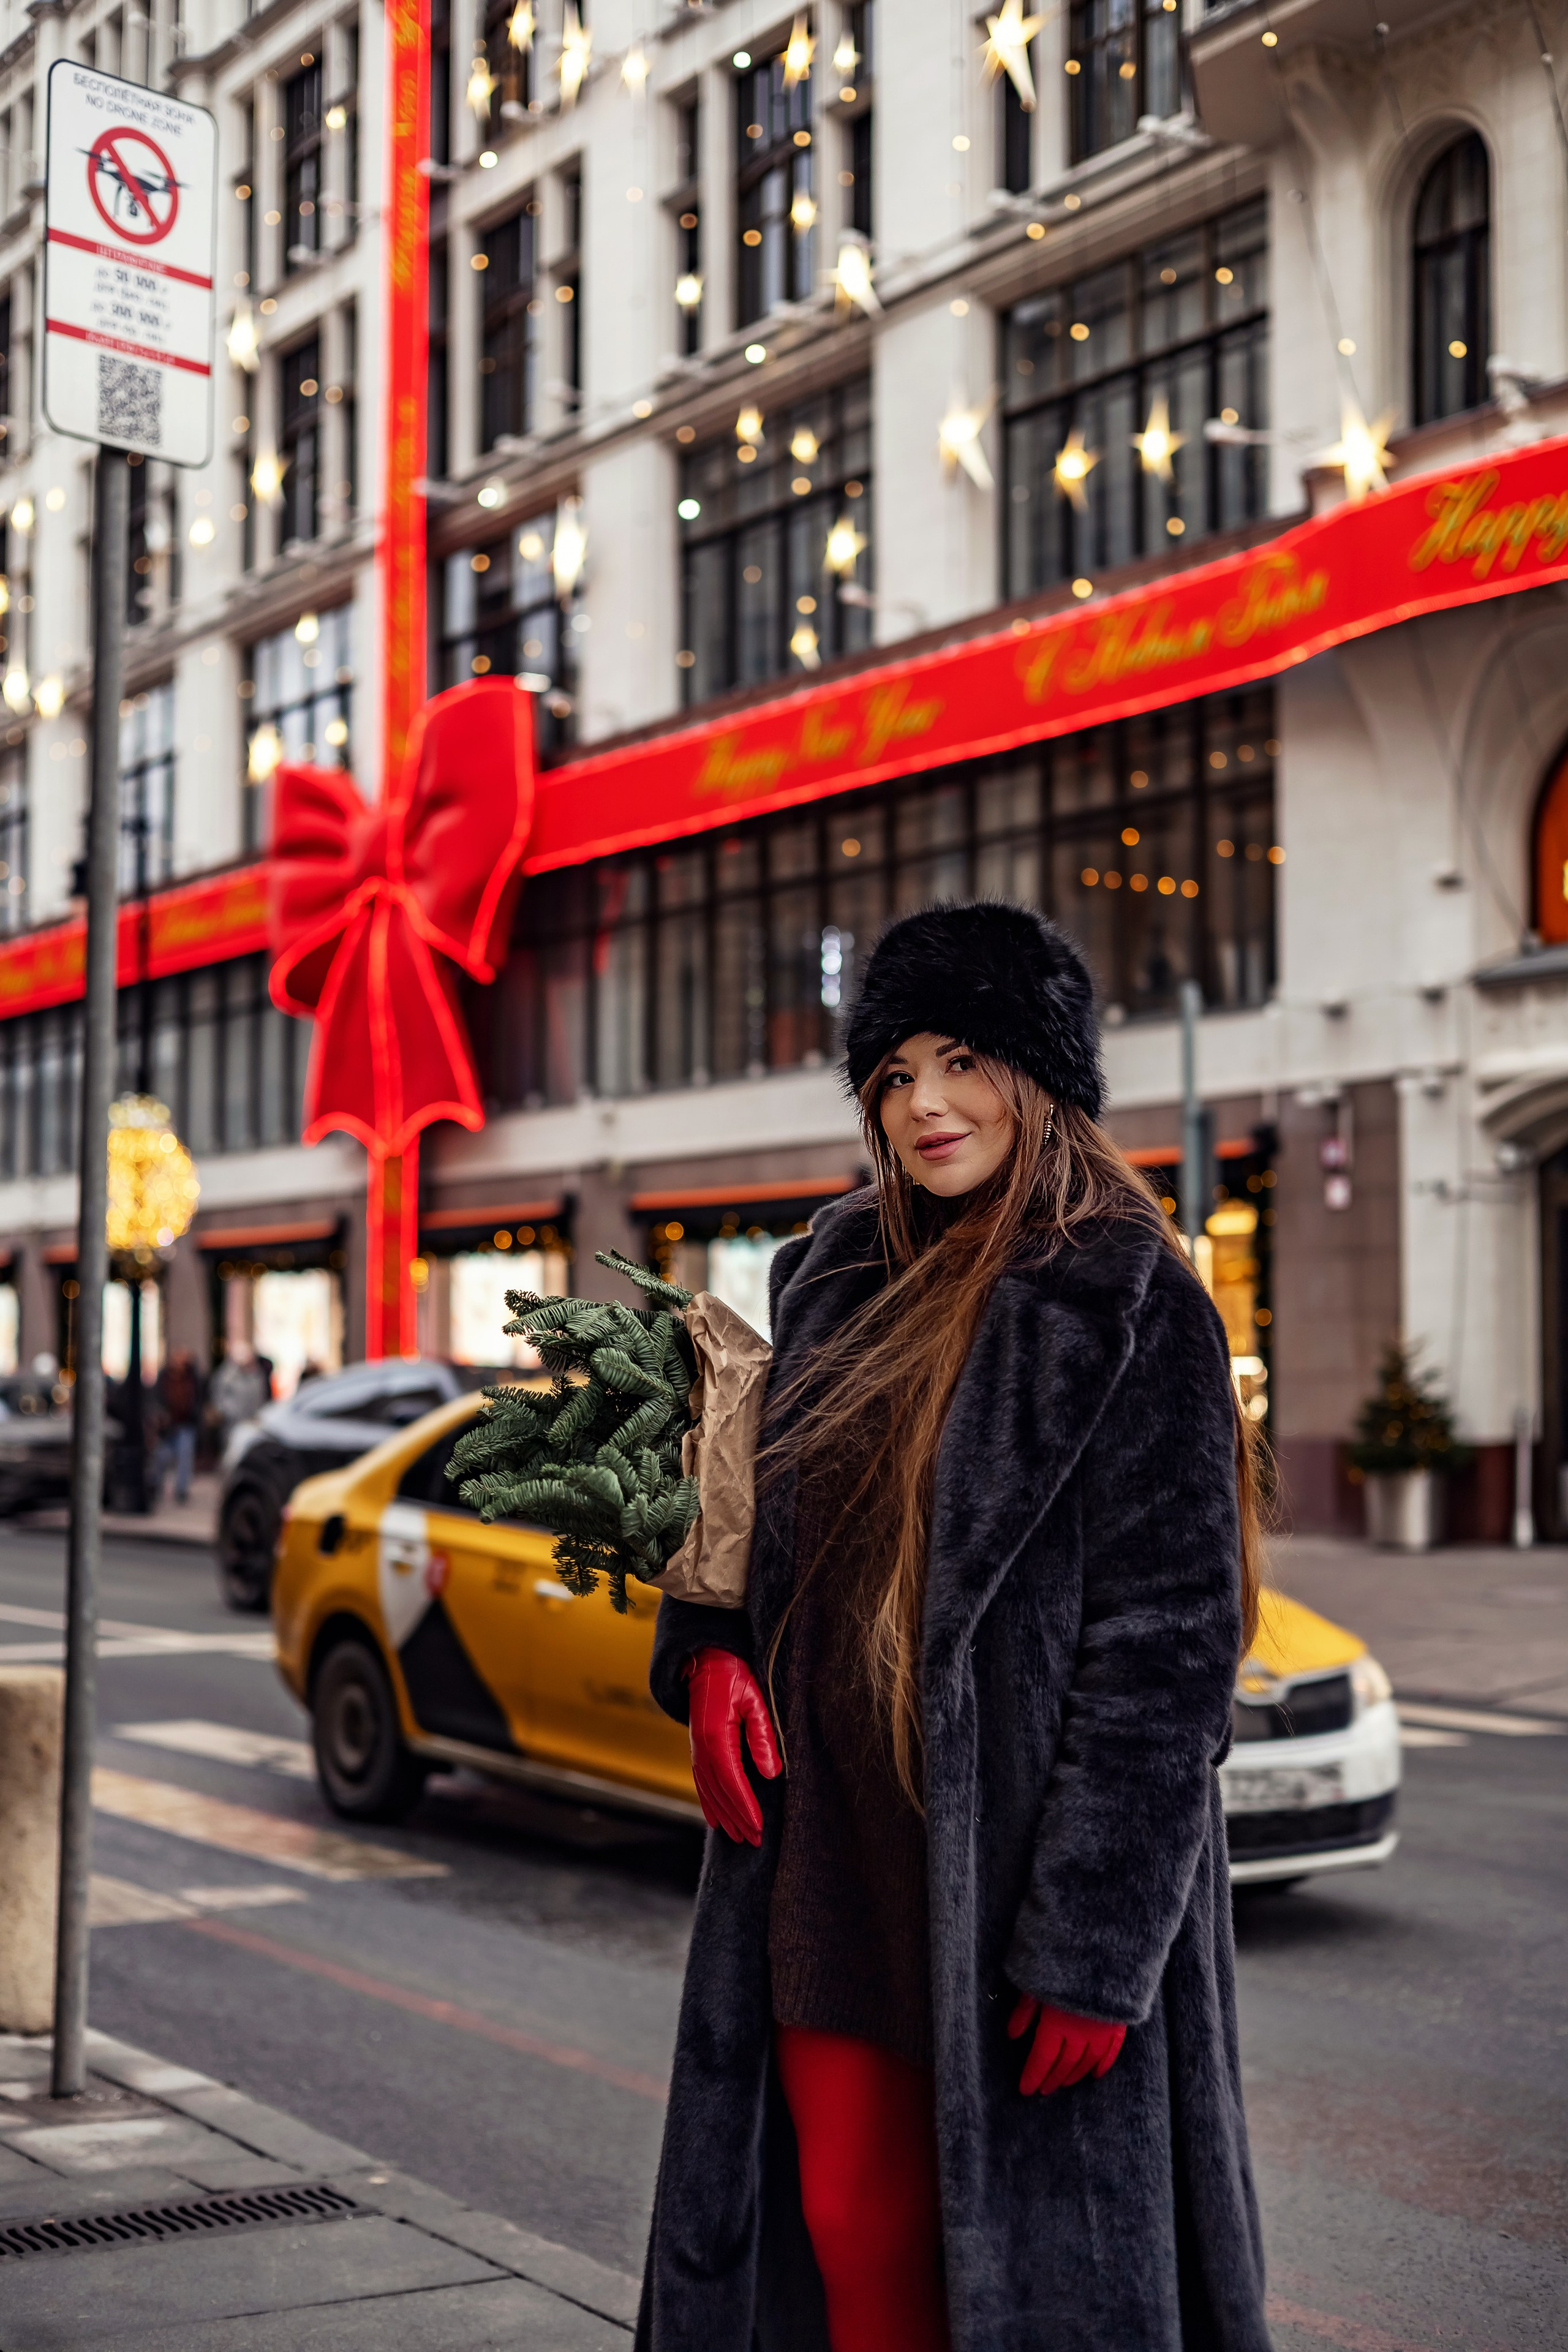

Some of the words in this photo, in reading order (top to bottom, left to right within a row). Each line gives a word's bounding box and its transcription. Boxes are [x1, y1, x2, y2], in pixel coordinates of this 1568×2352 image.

[86, 94, 103, 108] NO
[107, 99, 148, 123] DRONE
[152, 115, 182, 135] ZONE
